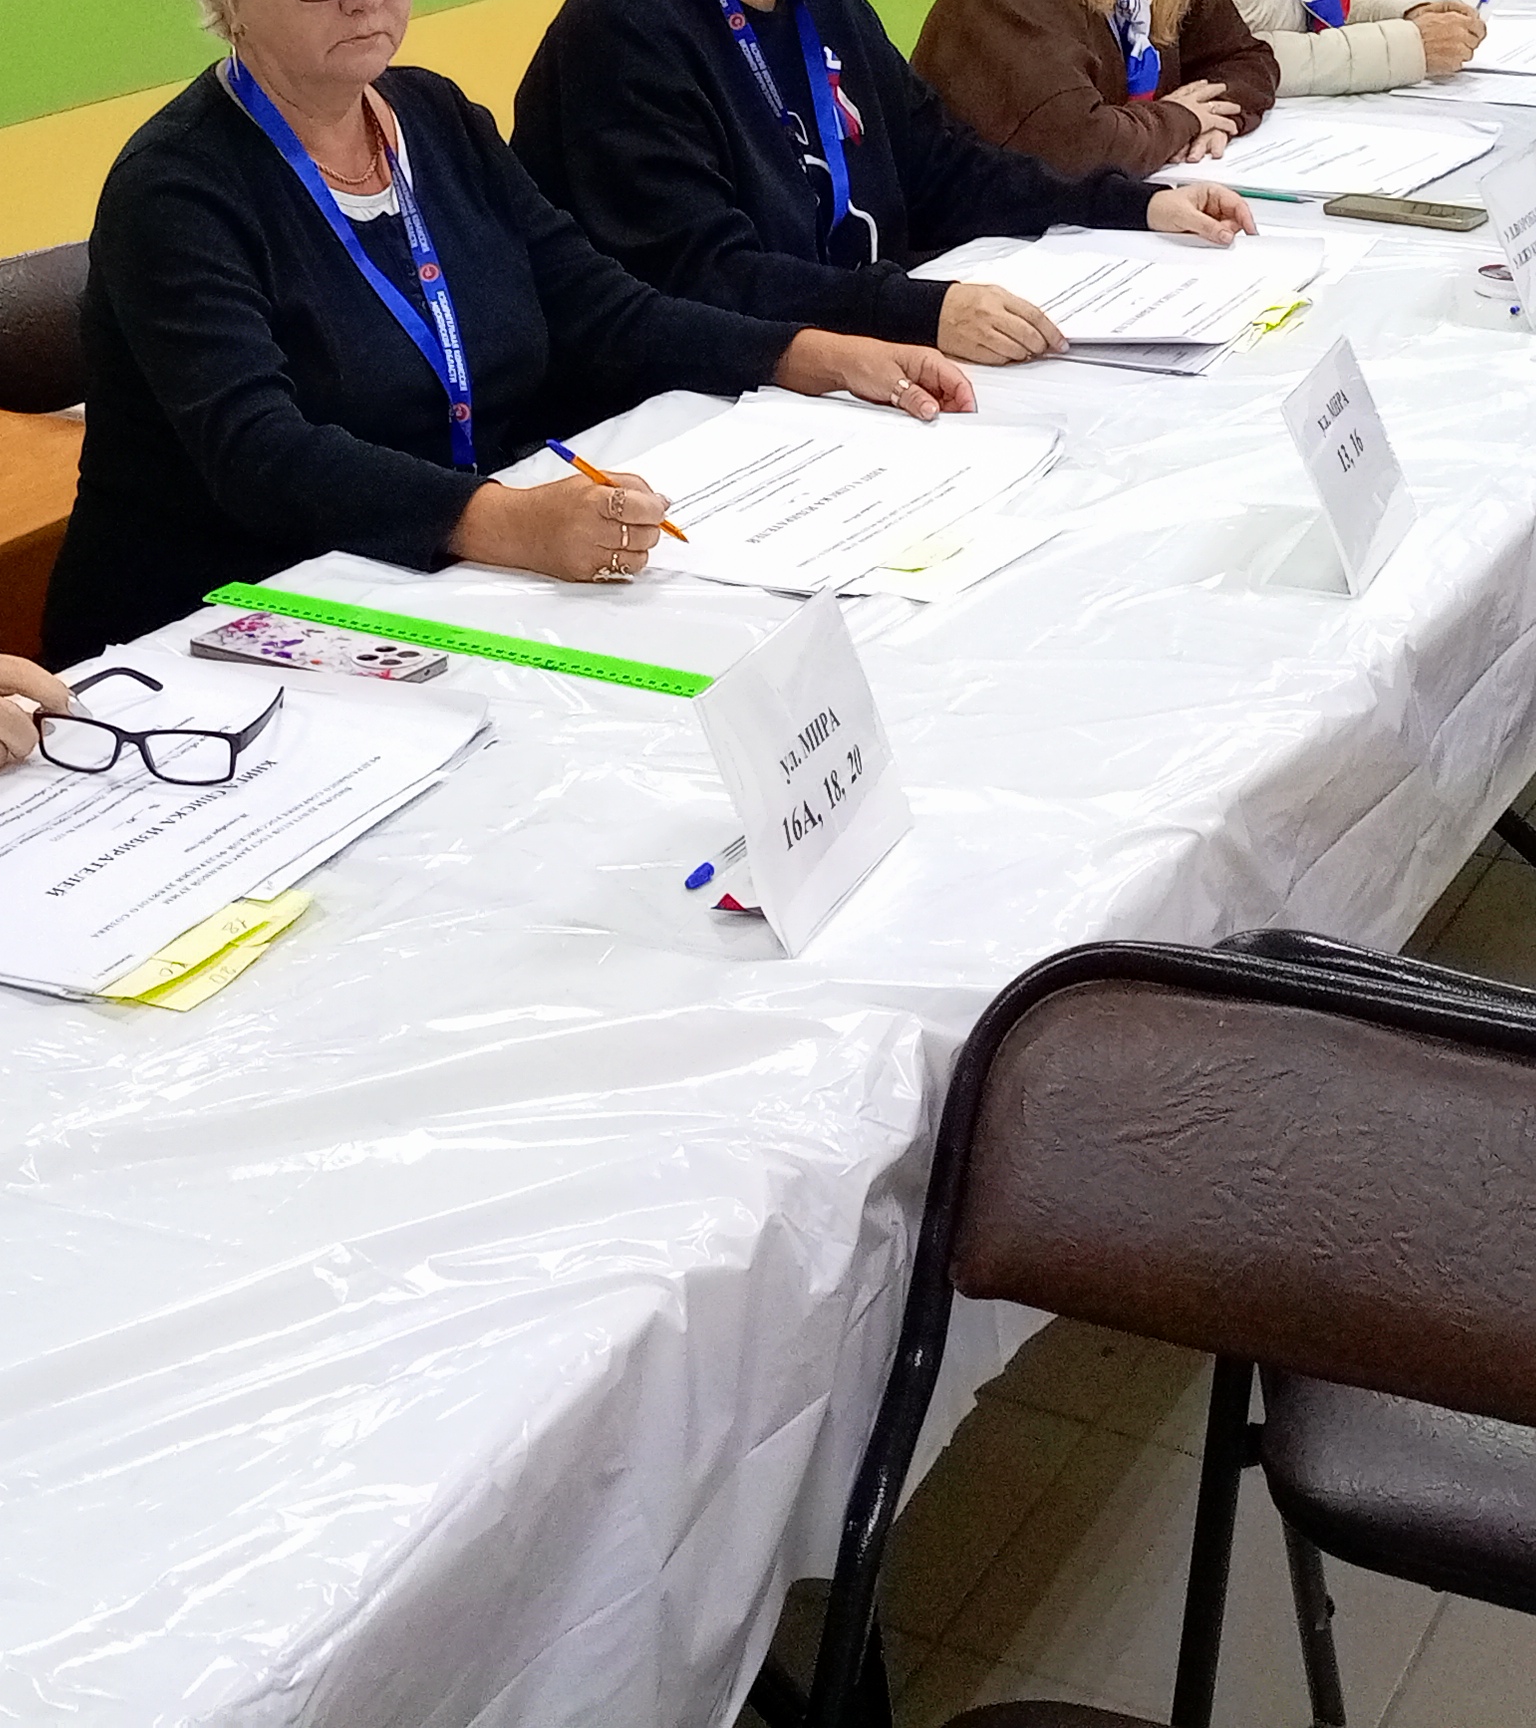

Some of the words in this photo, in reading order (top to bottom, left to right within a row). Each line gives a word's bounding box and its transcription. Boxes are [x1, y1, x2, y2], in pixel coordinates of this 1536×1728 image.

[1326, 389, 1350, 418] МИРА
[1350, 428, 1364, 457] 16
[779, 751, 802, 785] ул.
[797, 706, 841, 760] МИРА
[218, 759, 279, 790] КНИГА
[156, 788, 229, 826] СПИСКА
[782, 800, 824, 851] 16А,
[823, 769, 847, 810] 18,
[847, 744, 863, 785] 20
[43, 825, 168, 898] ИЗБИРАТЕЛЕЙ
